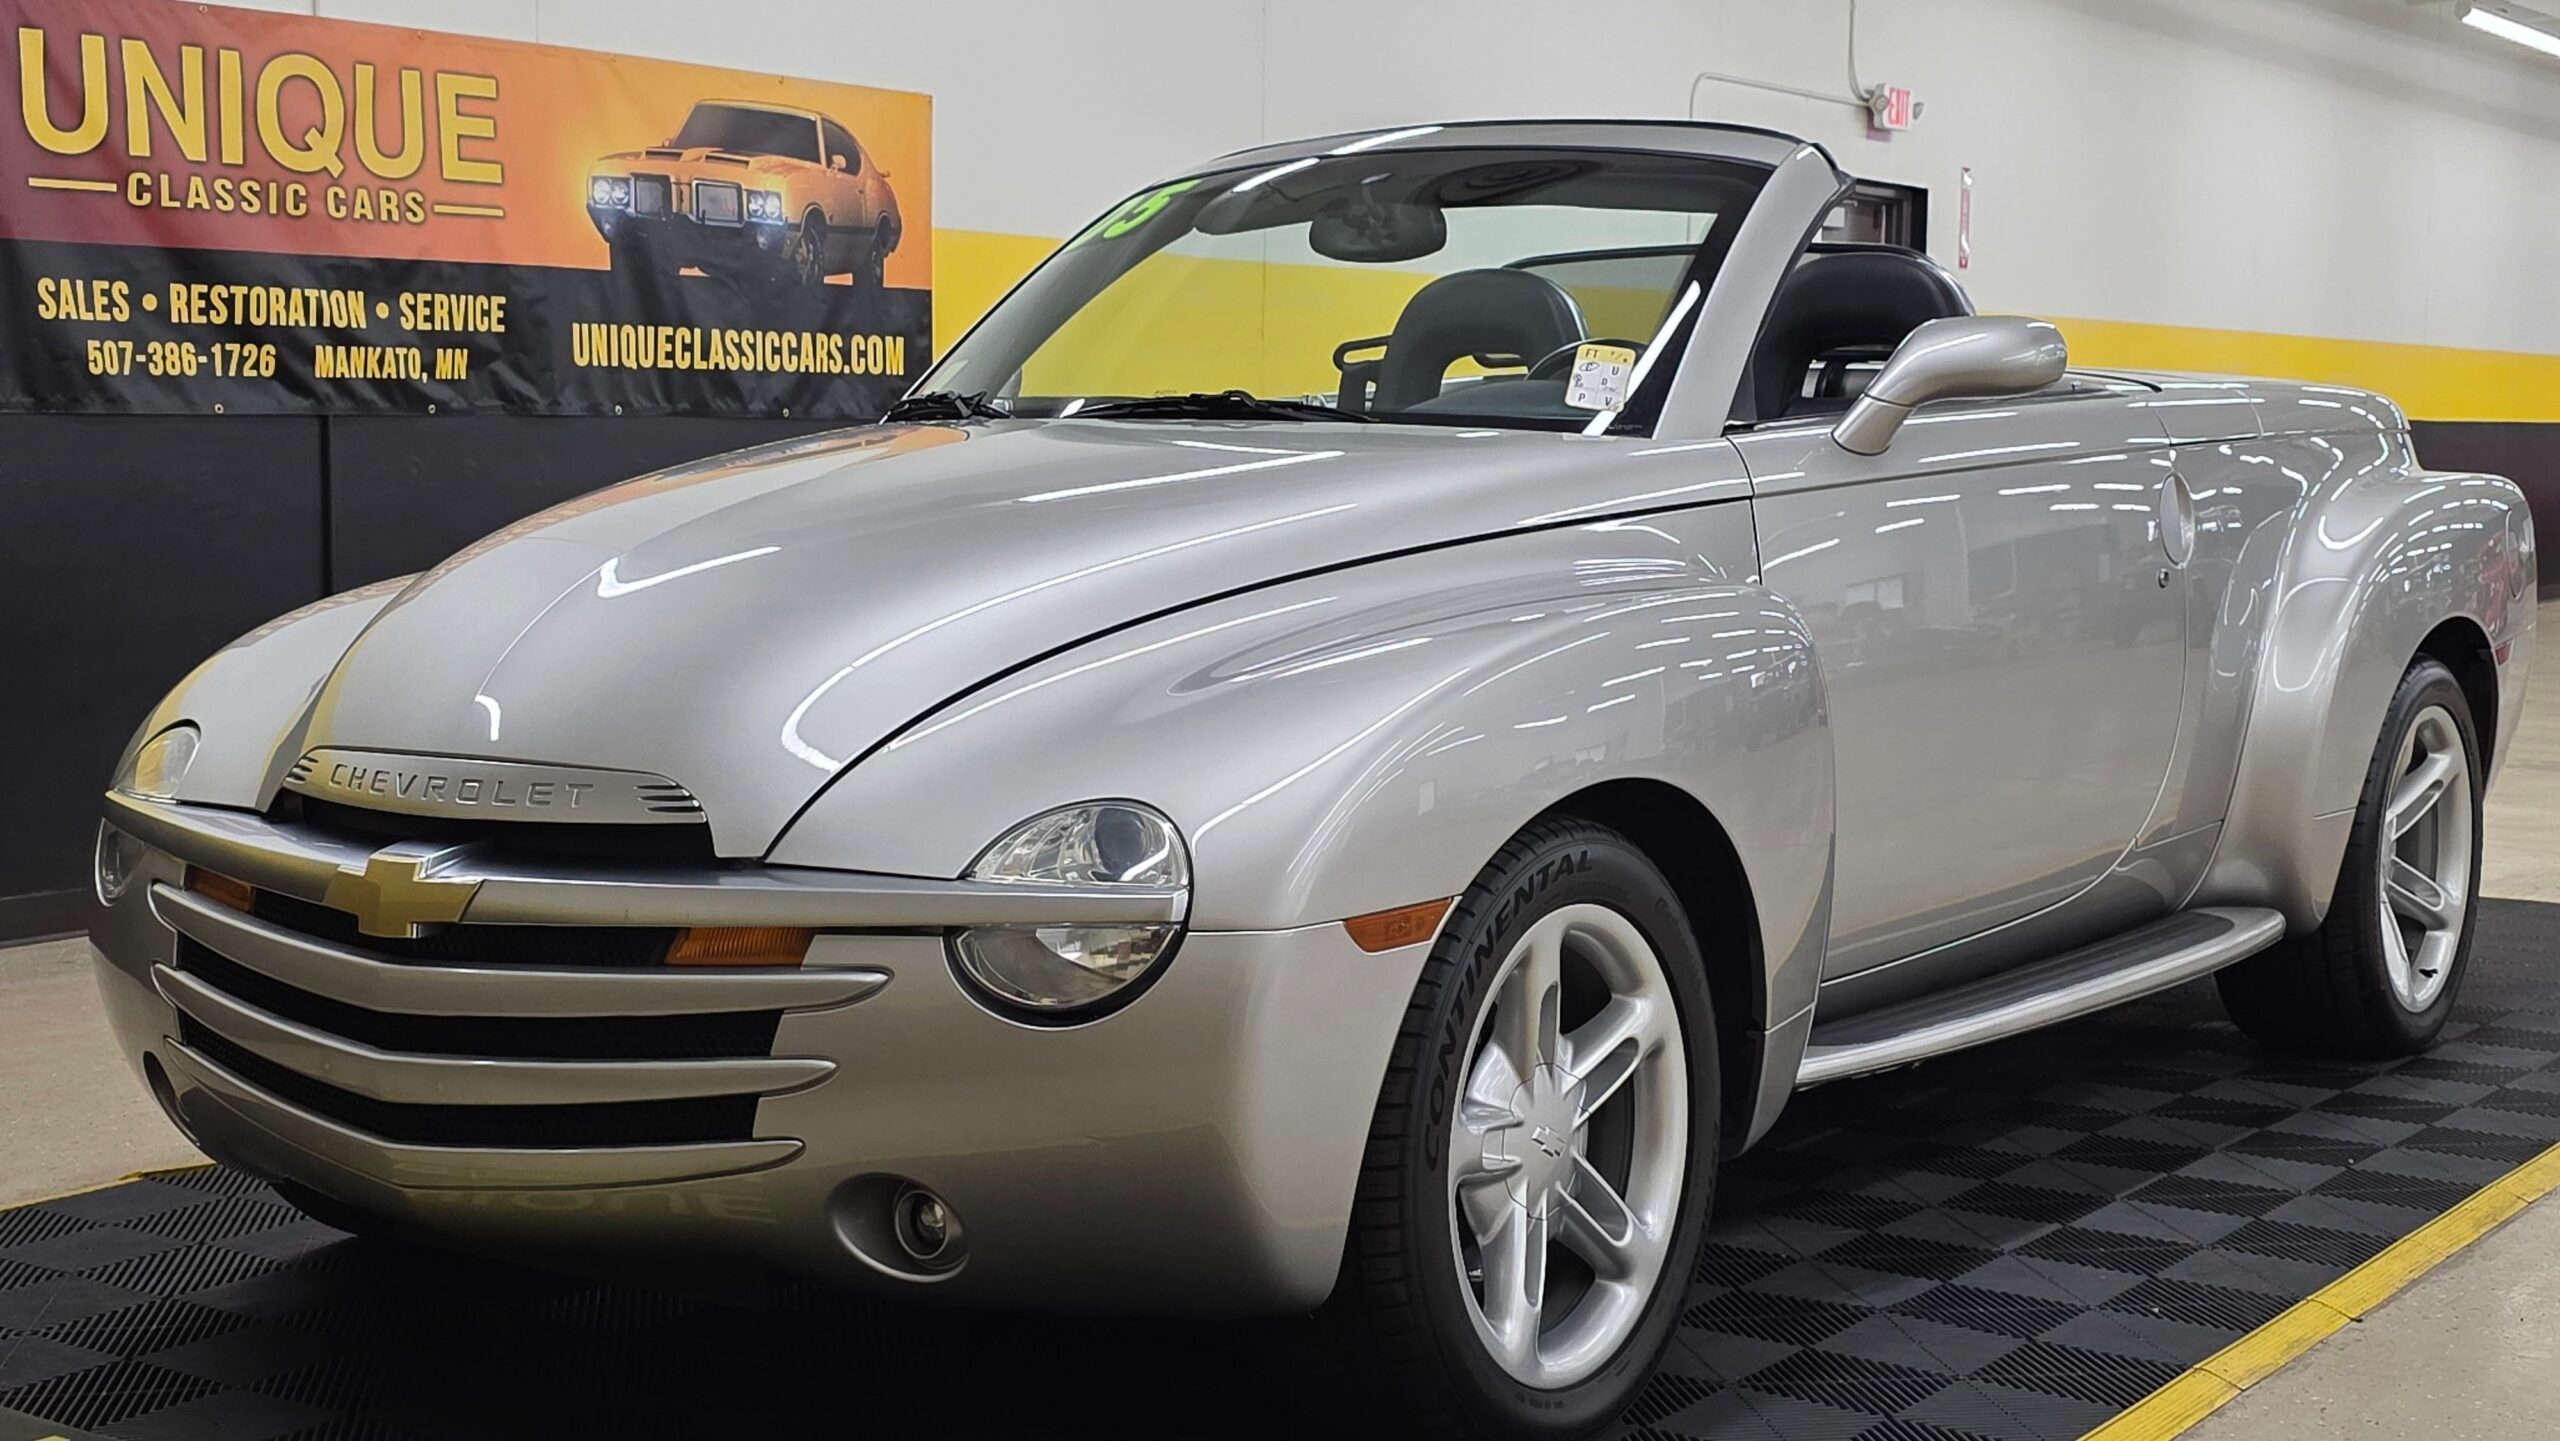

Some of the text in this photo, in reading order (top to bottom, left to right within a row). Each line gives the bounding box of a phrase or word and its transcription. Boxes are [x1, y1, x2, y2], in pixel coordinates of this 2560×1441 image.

[19, 28, 503, 184] UNIQUE
[1888, 87, 1910, 127] EXIT
[127, 172, 427, 224] CLASSIC CARS
[37, 277, 507, 333] SALES RESTORATION SERVICE
[87, 340, 469, 384] 507-386-1726 MANKATO, MN
[572, 323, 905, 376] UNIQUECLASSICCARS.COM
[329, 763, 594, 808] CHEVROLET
[1424, 849, 1594, 1172] CONTINENTAL
